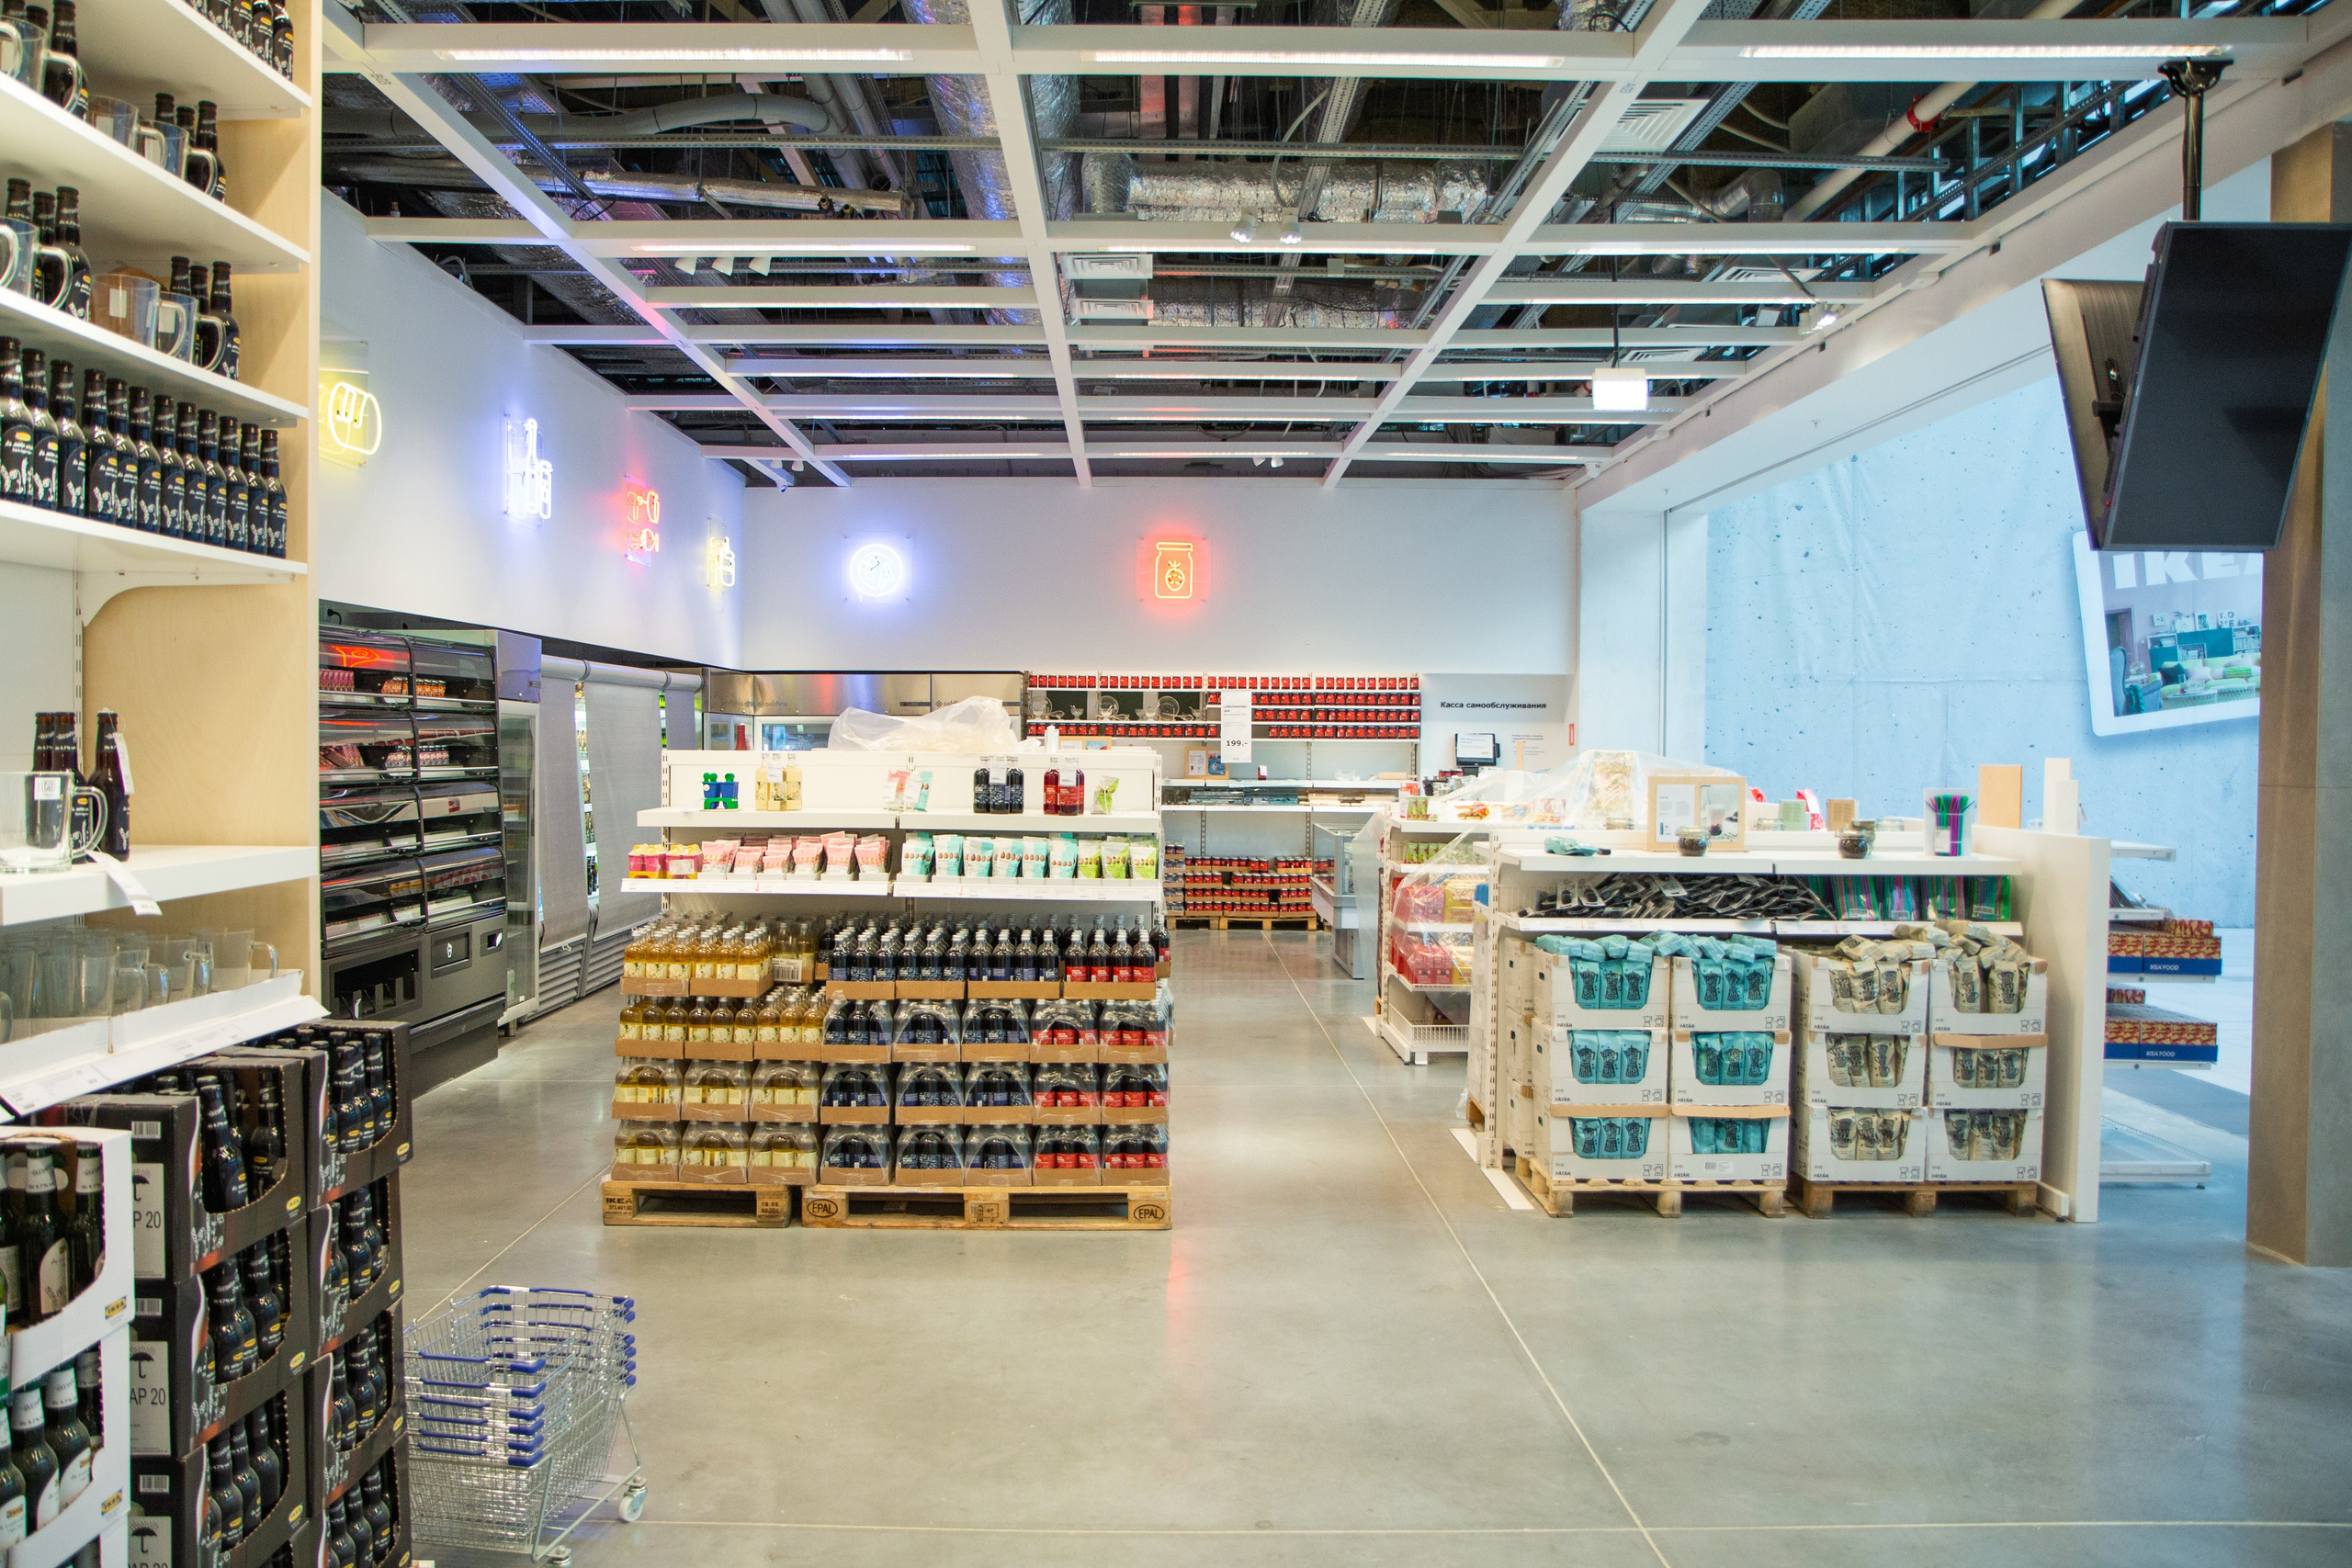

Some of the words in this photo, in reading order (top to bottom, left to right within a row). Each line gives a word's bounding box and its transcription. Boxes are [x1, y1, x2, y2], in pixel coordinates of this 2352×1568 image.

[1466, 701, 1547, 710] самообслуживания
[812, 1201, 833, 1213] EPAL
[1138, 1208, 1159, 1219] EPAL
[133, 1211, 141, 1228] P
[145, 1211, 161, 1228] 20
[107, 1299, 126, 1314] IKEA
[130, 1388, 147, 1404] AP
[151, 1388, 166, 1405] 20
[103, 1494, 121, 1511] IKEA
